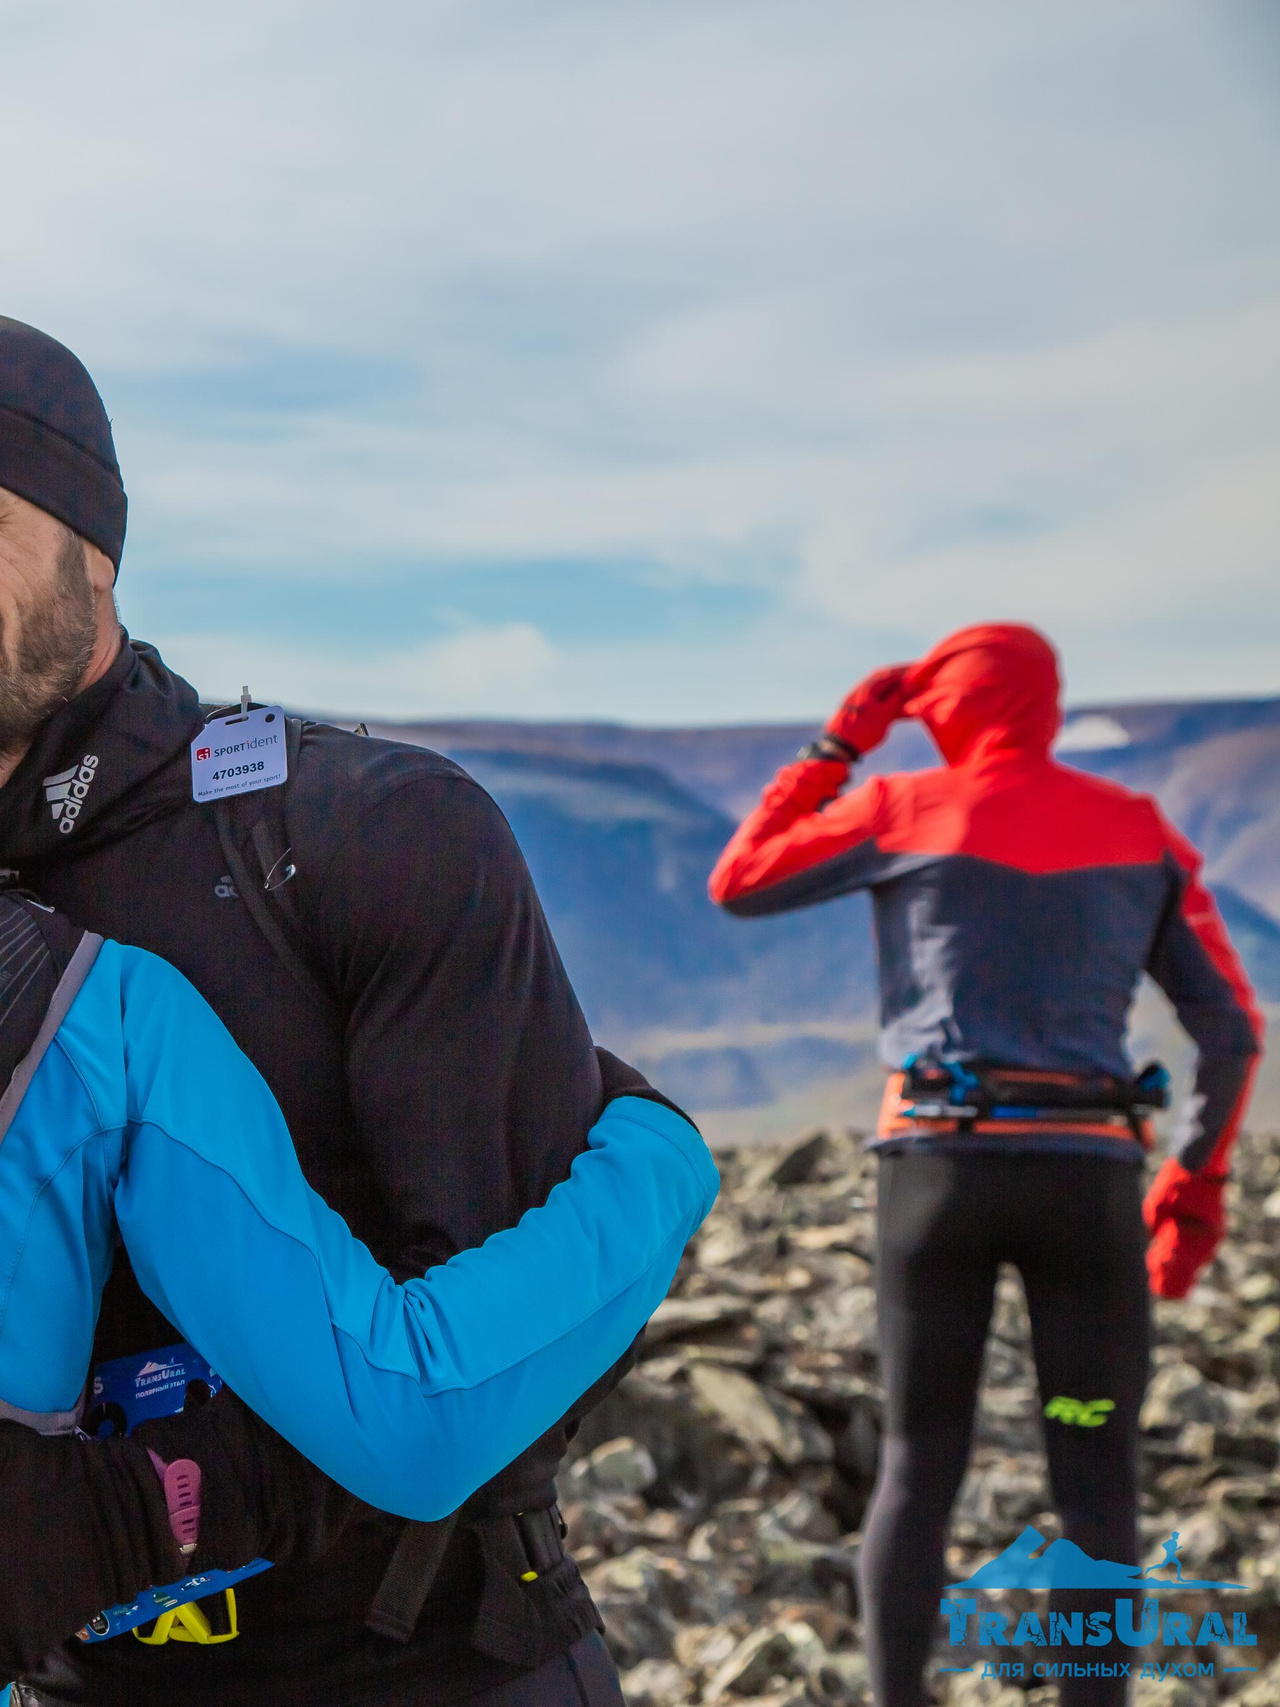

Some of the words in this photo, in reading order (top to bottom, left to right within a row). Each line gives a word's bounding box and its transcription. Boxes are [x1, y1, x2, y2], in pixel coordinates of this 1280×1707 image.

[214, 735, 278, 758] SPORTident
[212, 761, 265, 781] 4703938
[59, 754, 99, 834] adidas
[197, 789, 213, 797] Make
[214, 786, 224, 794] the
[225, 783, 240, 791] most
[249, 779, 262, 787] your
[263, 774, 281, 784] sport!
